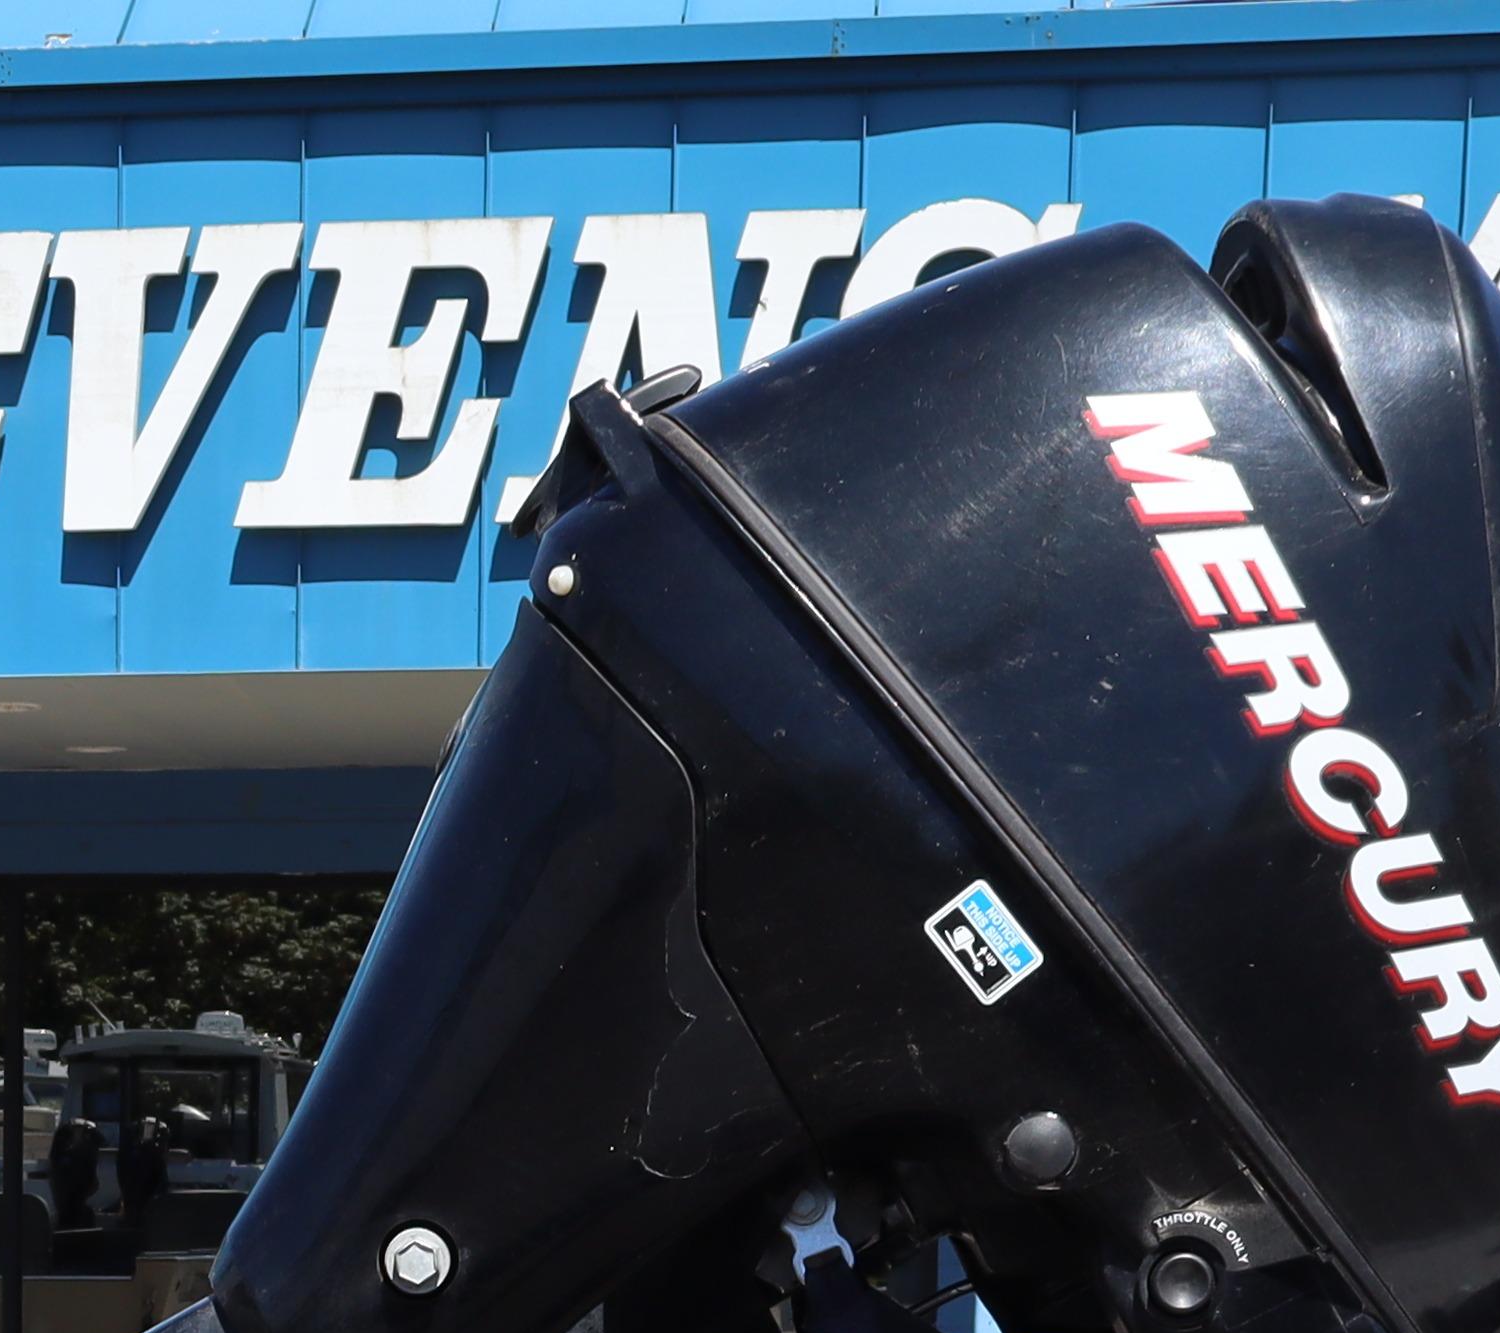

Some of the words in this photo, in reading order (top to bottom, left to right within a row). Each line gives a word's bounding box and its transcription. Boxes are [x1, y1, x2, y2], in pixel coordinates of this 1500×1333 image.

[966, 900, 989, 929] THIS
[985, 924, 1010, 954] SIDE
[1004, 950, 1022, 968] UP
[985, 906, 1021, 948] NOTICE
[1153, 1211, 1228, 1233] THROTTLE
[1226, 1230, 1249, 1263] ONLY
